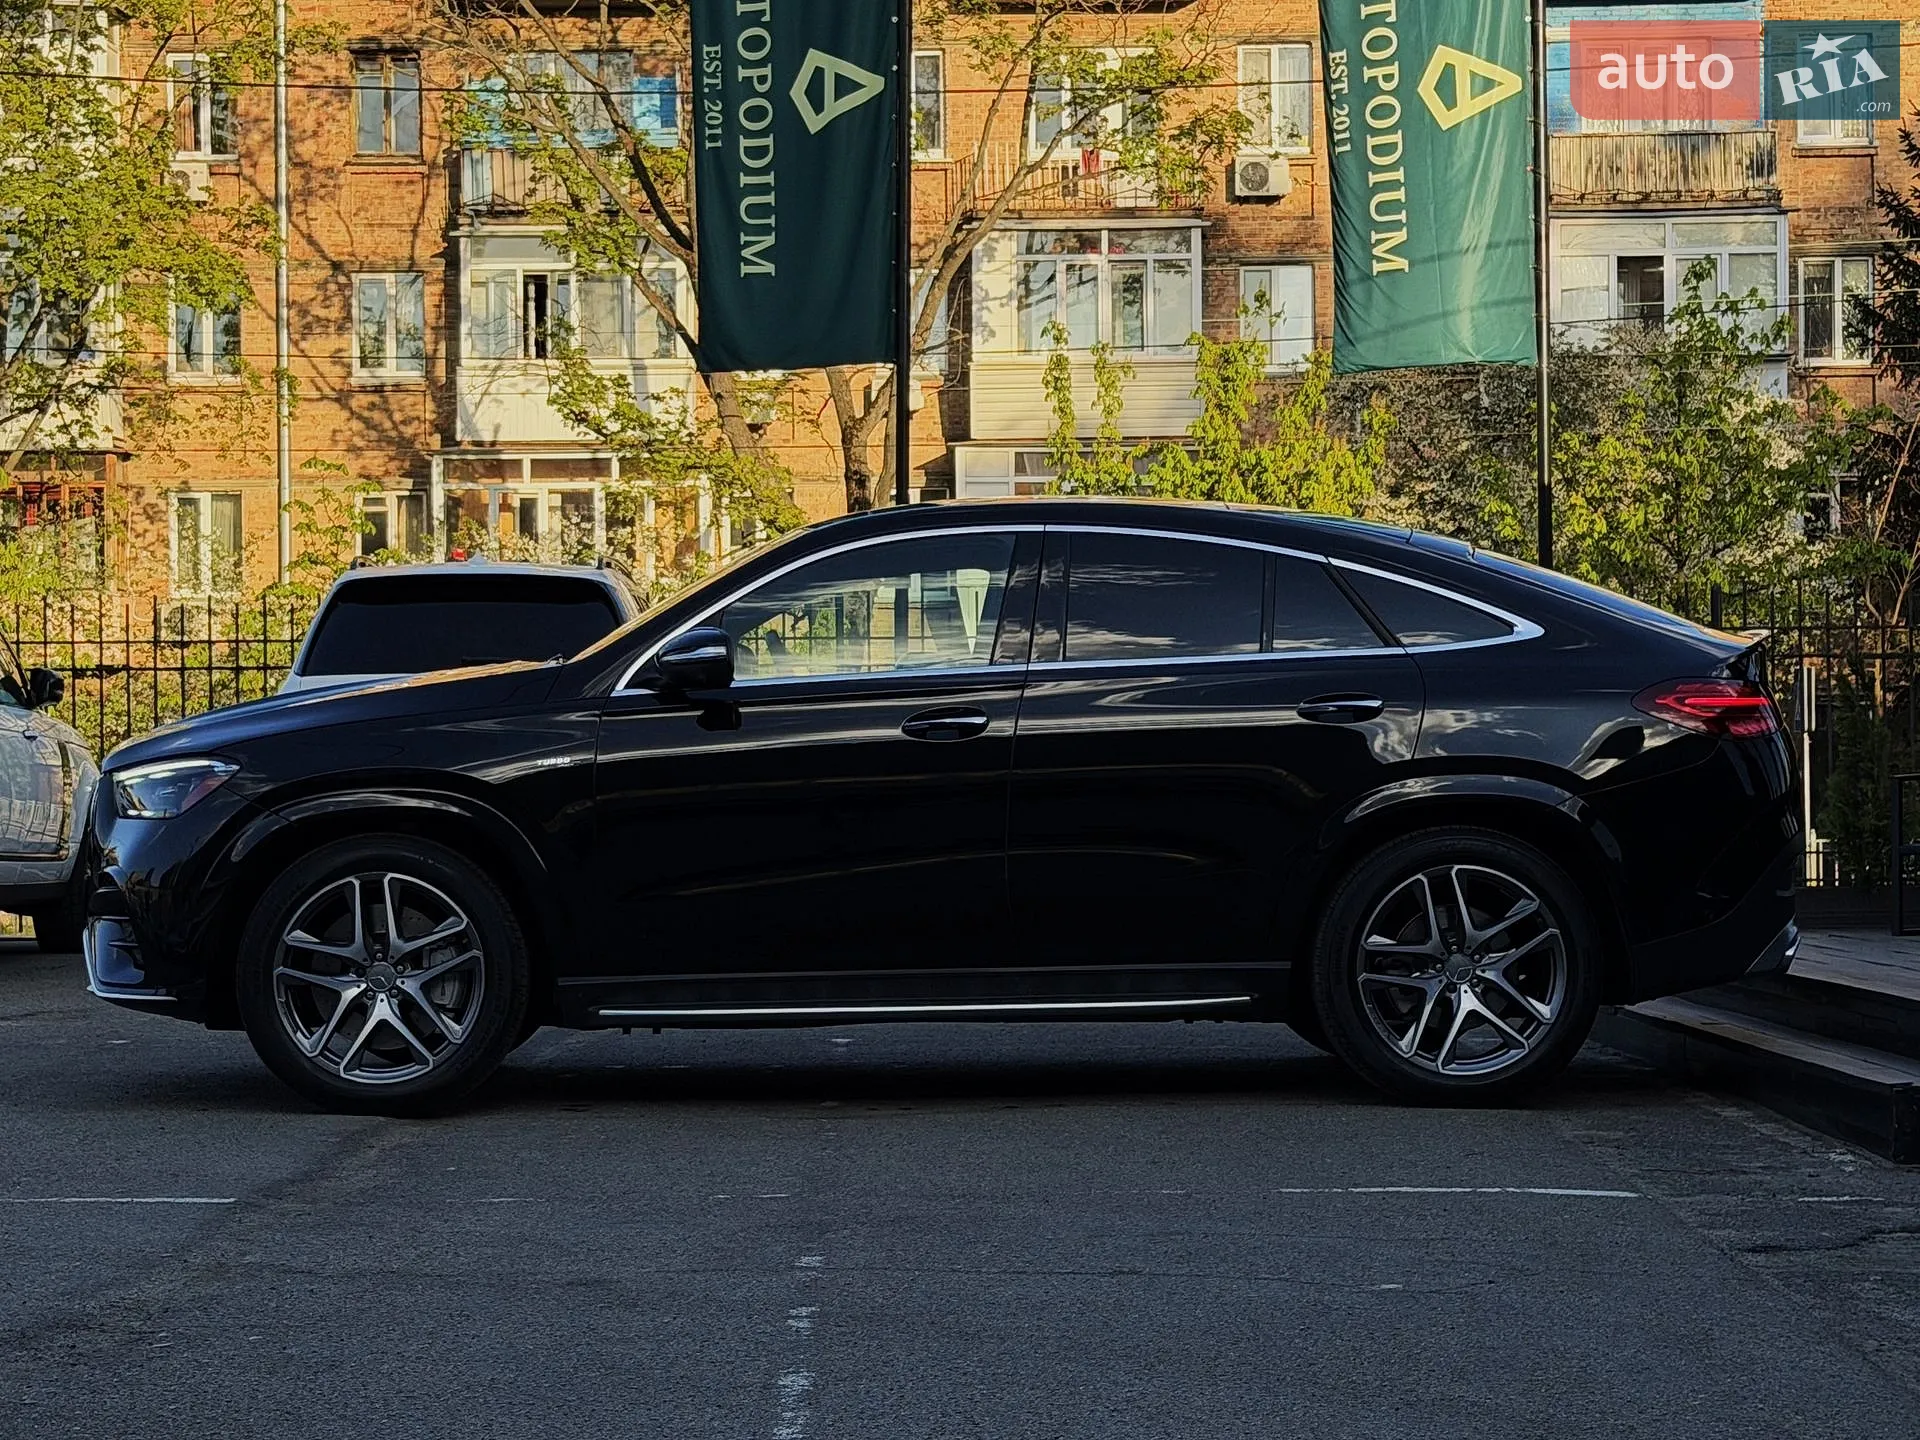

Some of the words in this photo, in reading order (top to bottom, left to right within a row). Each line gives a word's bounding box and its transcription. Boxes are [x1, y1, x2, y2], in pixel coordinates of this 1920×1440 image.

[703, 43, 722, 93] EST.
[1328, 48, 1349, 101] EST.
[704, 99, 723, 150] 2011
[1332, 103, 1351, 156] 2011
